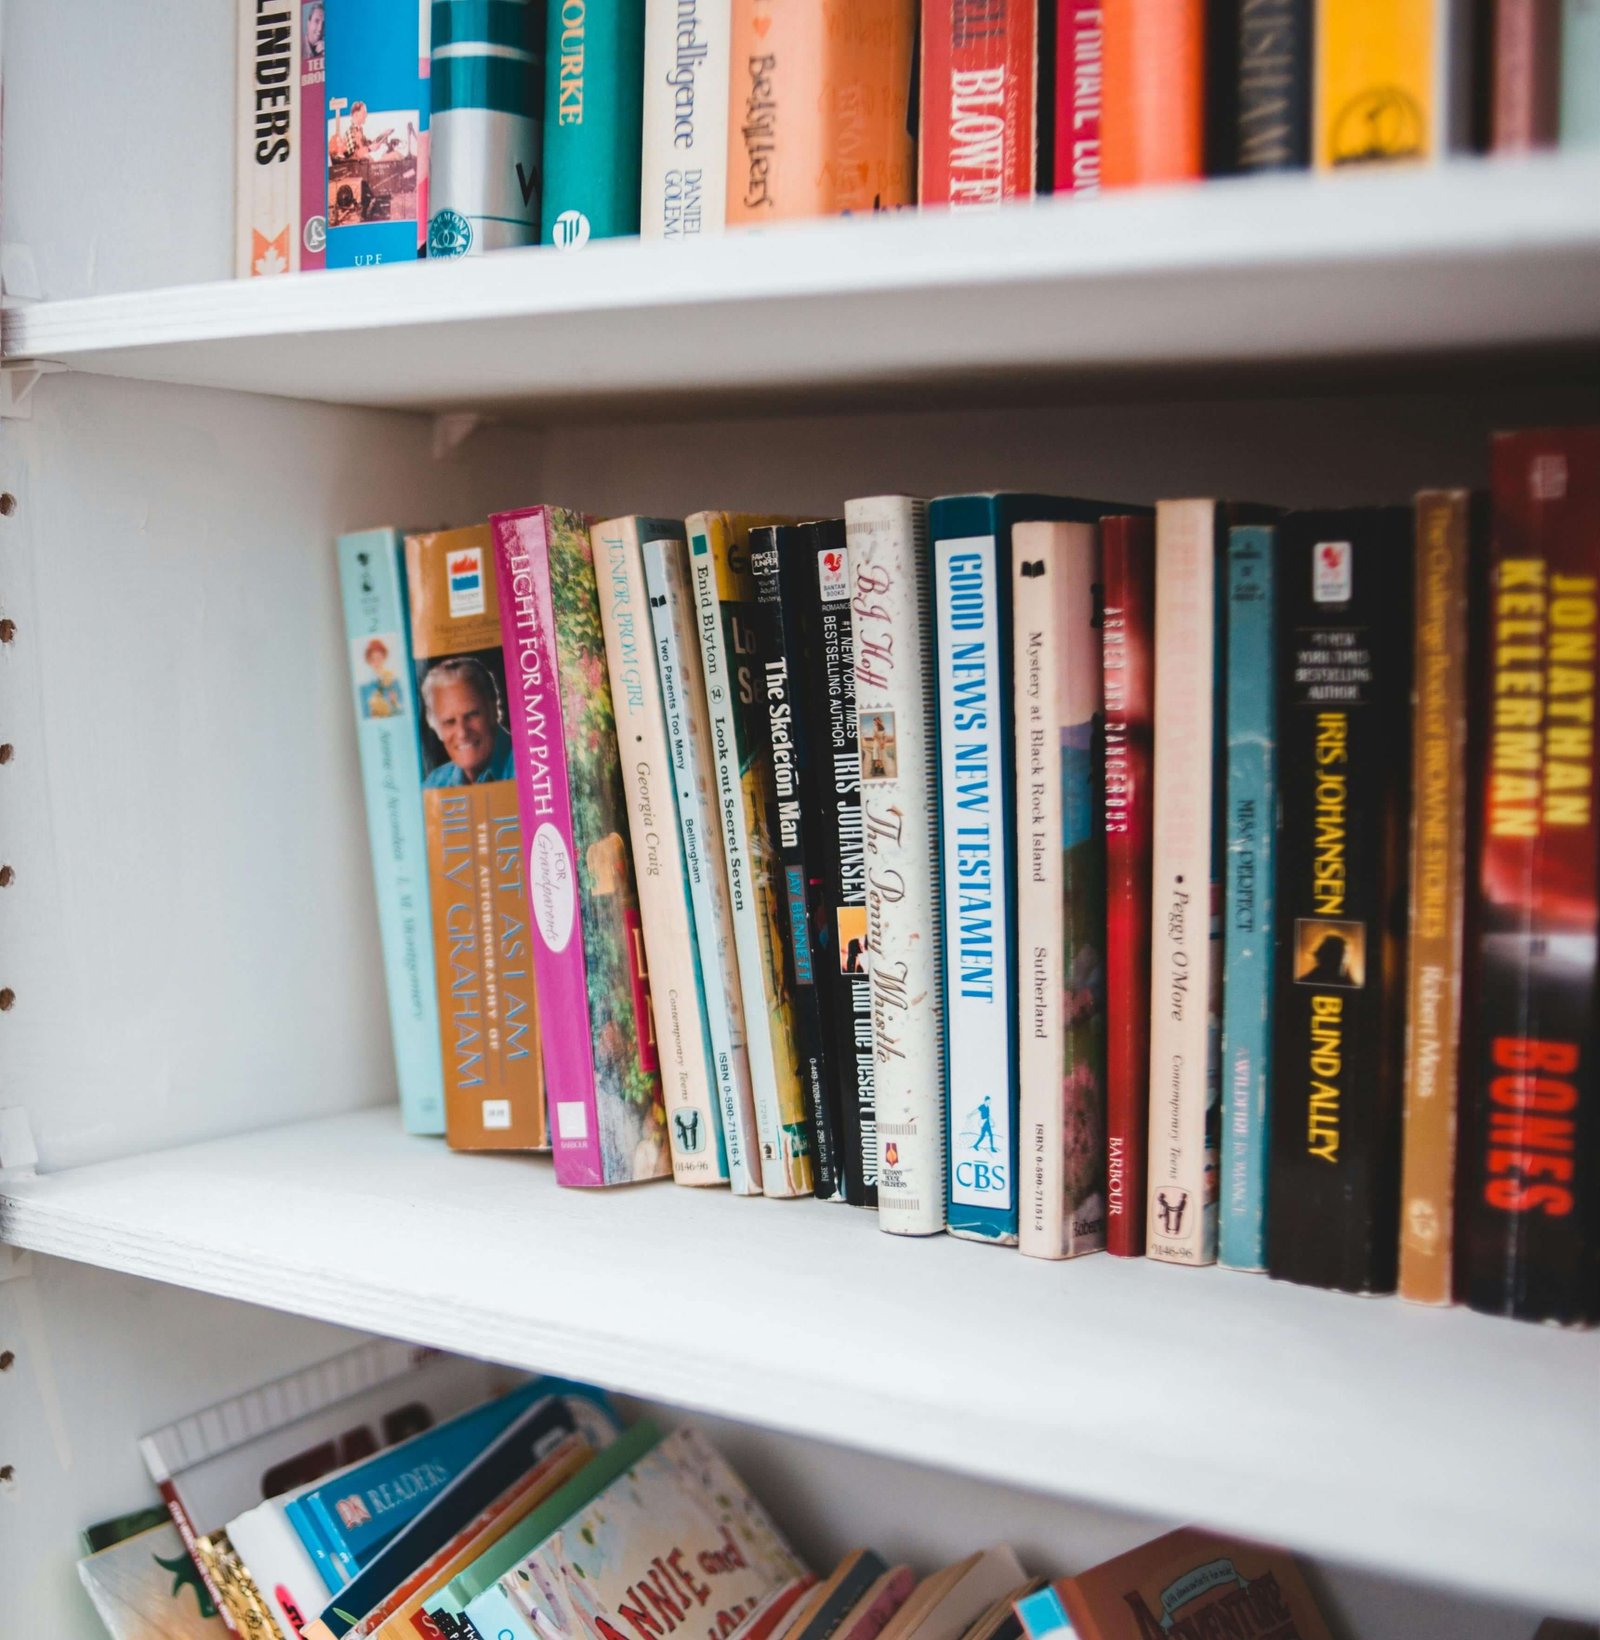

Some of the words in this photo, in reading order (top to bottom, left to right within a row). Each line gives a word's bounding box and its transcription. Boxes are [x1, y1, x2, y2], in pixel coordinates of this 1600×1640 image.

[950, 65, 1004, 173] BLOW
[510, 554, 538, 632] LIGHT
[697, 564, 711, 606] Enid
[947, 553, 984, 631] GOOD
[519, 636, 543, 691] FOR
[617, 613, 640, 665] PROM
[659, 637, 670, 662] Two
[702, 613, 719, 674] Blyton
[823, 615, 842, 696] BESTSELLING
[841, 636, 854, 661] NEW
[1027, 632, 1043, 699] Mystery
[619, 668, 644, 717] GIRL
[663, 665, 677, 709] Parents
[764, 656, 788, 700] The
[951, 641, 988, 732] NEWS
[1307, 686, 1358, 699] AUTHOR
[1490, 557, 1546, 838] KELLERMAN
[1543, 572, 1596, 826] JONATHAN
[524, 694, 547, 740] MY
[670, 712, 681, 736] Too
[715, 716, 727, 760] Look
[829, 698, 846, 748] AUTHOR
[1030, 706, 1042, 722] at
[1315, 712, 1347, 764] IRIS
[674, 739, 686, 771] Many
[768, 703, 795, 797] Skeleton
[953, 742, 992, 814] NEW
[1029, 729, 1045, 775] Black
[529, 744, 554, 817] PATH
[635, 761, 657, 827] Georgia
[721, 765, 734, 795] out
[1031, 782, 1046, 824] Rock
[441, 795, 473, 890] BILLY
[477, 822, 489, 855] THE
[684, 818, 701, 884] Bellingham
[724, 799, 740, 855] Secret
[778, 801, 803, 849] Man
[865, 798, 903, 855] The
[1314, 768, 1347, 915] JOHANSEN
[491, 814, 523, 898] JUST
[552, 851, 567, 881] FOR
[645, 831, 663, 876] Craig
[1032, 832, 1047, 883] Island
[731, 859, 744, 912] Seven
[787, 870, 802, 896] JAY
[500, 914, 525, 960] AS
[791, 901, 811, 979] BENNETT
[867, 866, 906, 961] Penny
[955, 822, 996, 1004] TESTAMENT
[1167, 890, 1189, 945] Peggy
[479, 866, 498, 1018] AUTOBIOGRAPHY
[446, 903, 485, 1089] GRAHAM
[872, 961, 909, 1064] Whistle
[1034, 946, 1048, 1039] Sutherland
[1171, 951, 1190, 1022] O'More
[1419, 965, 1444, 1036] Robert
[488, 1028, 500, 1051] OF
[504, 991, 529, 1061] AM
[668, 988, 685, 1068] Contemporary
[678, 1069, 690, 1102] Teens
[1310, 996, 1343, 1078] BLIND
[717, 1051, 730, 1081] ISBN
[1168, 1055, 1182, 1141] Contemporary
[1307, 1080, 1341, 1164] ALLEY
[1035, 1123, 1044, 1152] ISBN
[1484, 1036, 1579, 1218] BONES
[956, 1160, 1006, 1192] CBS
[1108, 1137, 1124, 1216] BARBOUR
[1168, 1146, 1181, 1180] Teens
